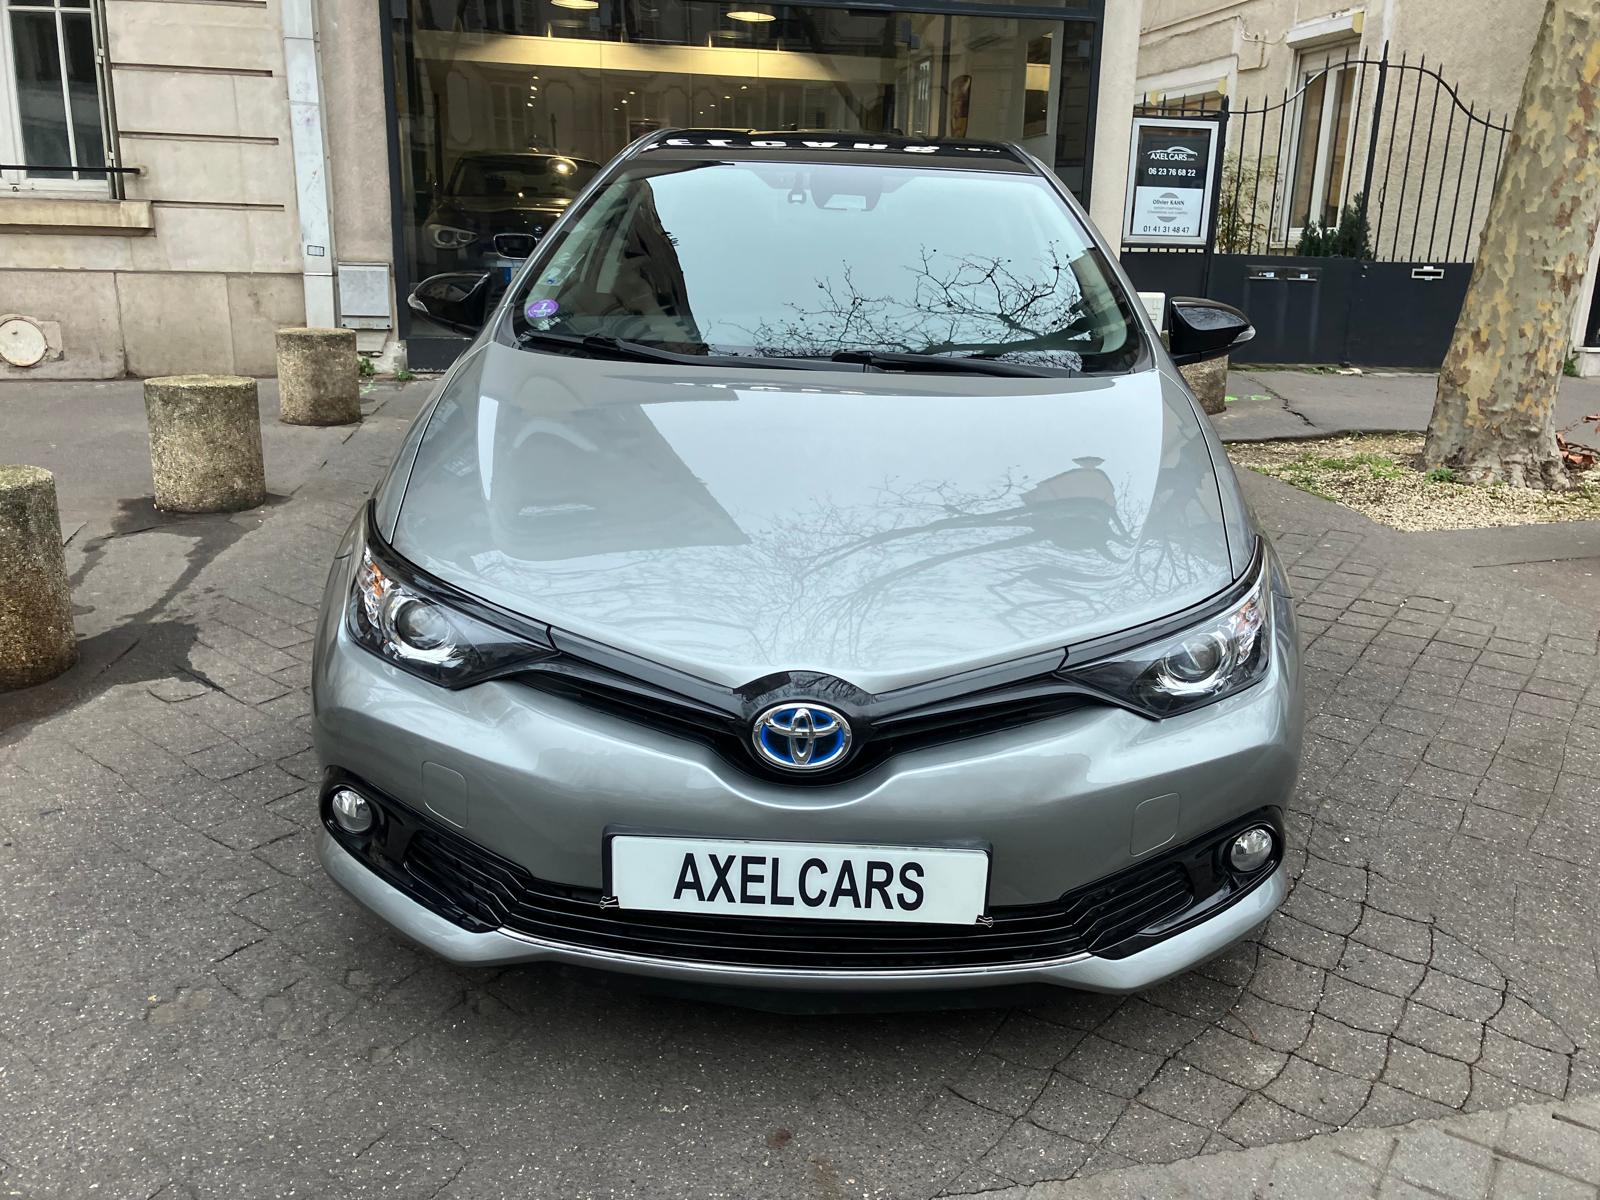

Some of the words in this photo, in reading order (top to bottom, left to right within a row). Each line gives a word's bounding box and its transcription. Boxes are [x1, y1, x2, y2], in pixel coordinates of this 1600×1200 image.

[1148, 167, 1157, 175] 06
[1168, 168, 1177, 176] 76
[1187, 169, 1196, 177] 22
[1153, 225, 1160, 233] 41
[672, 852, 926, 911] AXELCARS
